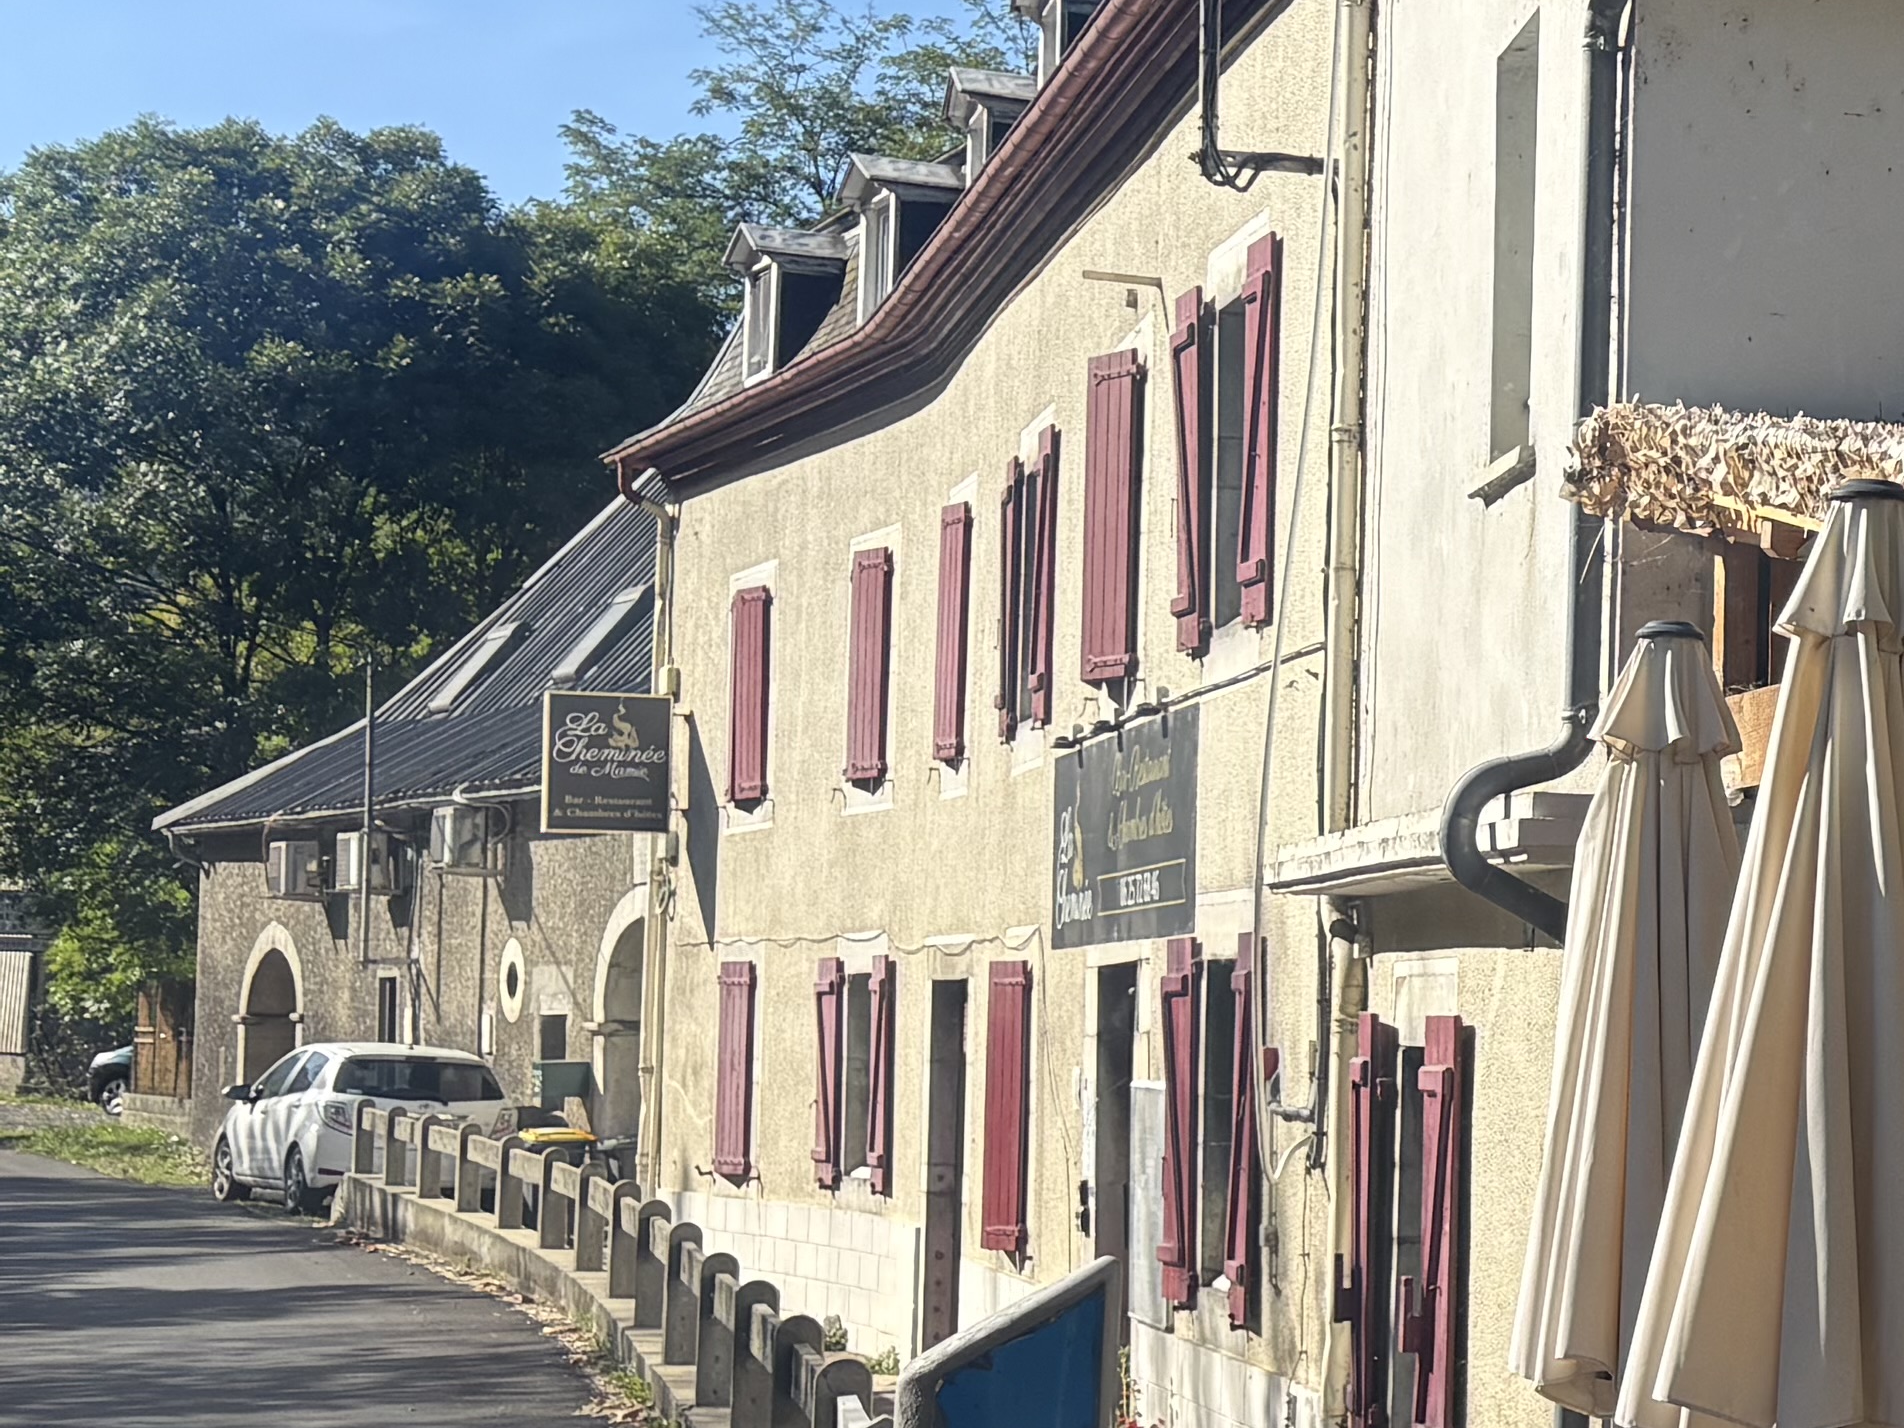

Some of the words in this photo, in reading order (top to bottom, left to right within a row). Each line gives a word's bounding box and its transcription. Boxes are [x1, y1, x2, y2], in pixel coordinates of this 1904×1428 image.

[566, 711, 609, 736] La
[553, 726, 667, 763] Cheminée
[569, 762, 588, 775] de
[590, 762, 651, 783] Mamie
[565, 795, 584, 805] Bar
[594, 796, 653, 807] Restaurant
[566, 807, 621, 819] Chambres
[1059, 805, 1074, 864] La
